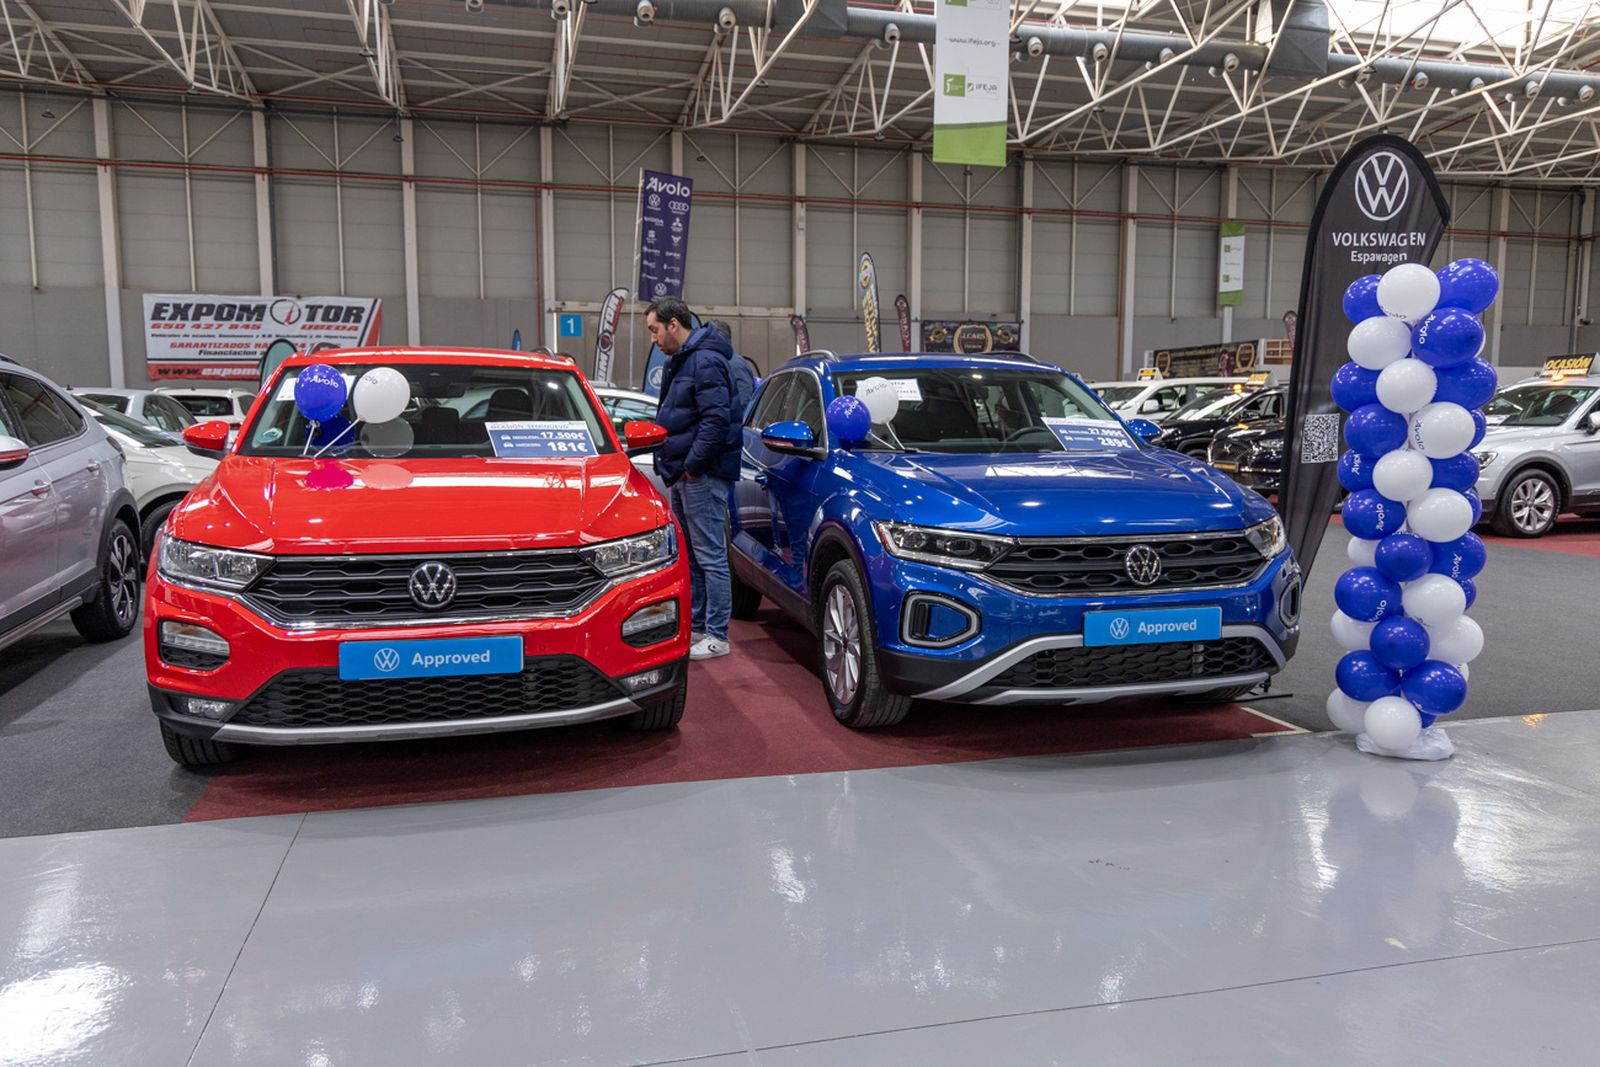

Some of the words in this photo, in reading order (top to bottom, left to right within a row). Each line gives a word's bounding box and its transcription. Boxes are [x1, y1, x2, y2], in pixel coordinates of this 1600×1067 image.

[1332, 232, 1426, 247] VOLKSWAGEN
[1351, 250, 1408, 264] Espawagen
[567, 318, 574, 335] 1
[1545, 355, 1593, 370] OCASIÓN
[310, 374, 340, 389] Avolo
[540, 431, 585, 440] 17.500€
[547, 441, 588, 452] 181€
[1138, 618, 1197, 636] Approved
[412, 649, 491, 668] Approved
